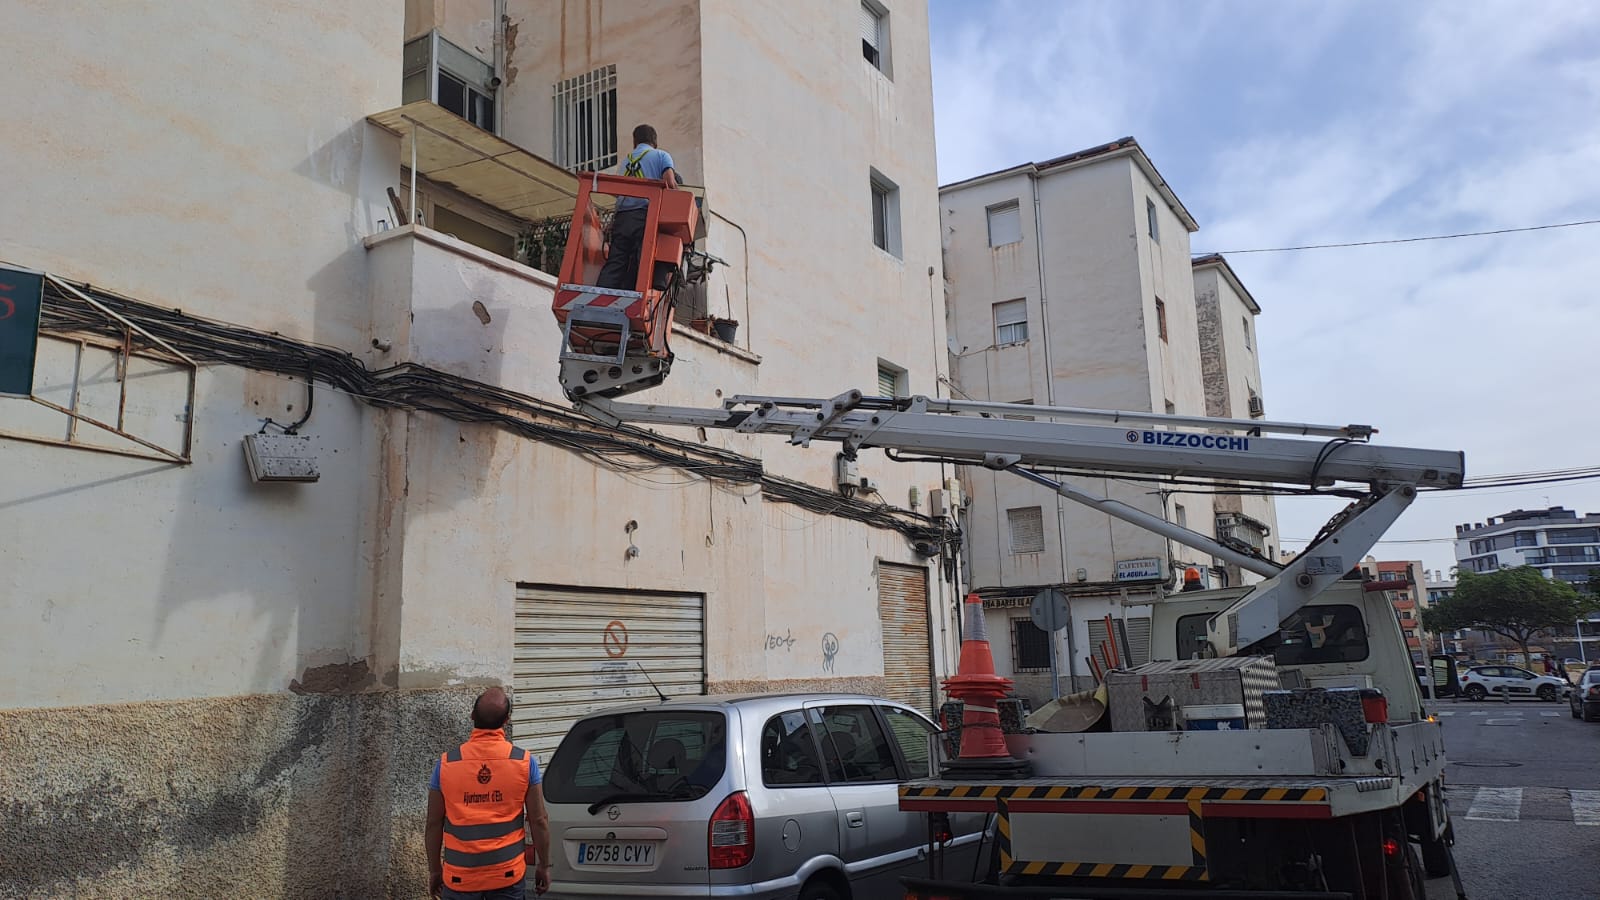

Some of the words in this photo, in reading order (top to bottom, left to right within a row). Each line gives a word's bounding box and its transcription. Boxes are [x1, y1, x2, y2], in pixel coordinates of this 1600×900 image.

[1143, 431, 1249, 451] BIZZOCCHI
[1119, 561, 1156, 570] CAFETERIA
[463, 791, 490, 806] Ajuntament
[586, 845, 620, 862] 6758
[623, 845, 652, 863] CVY
